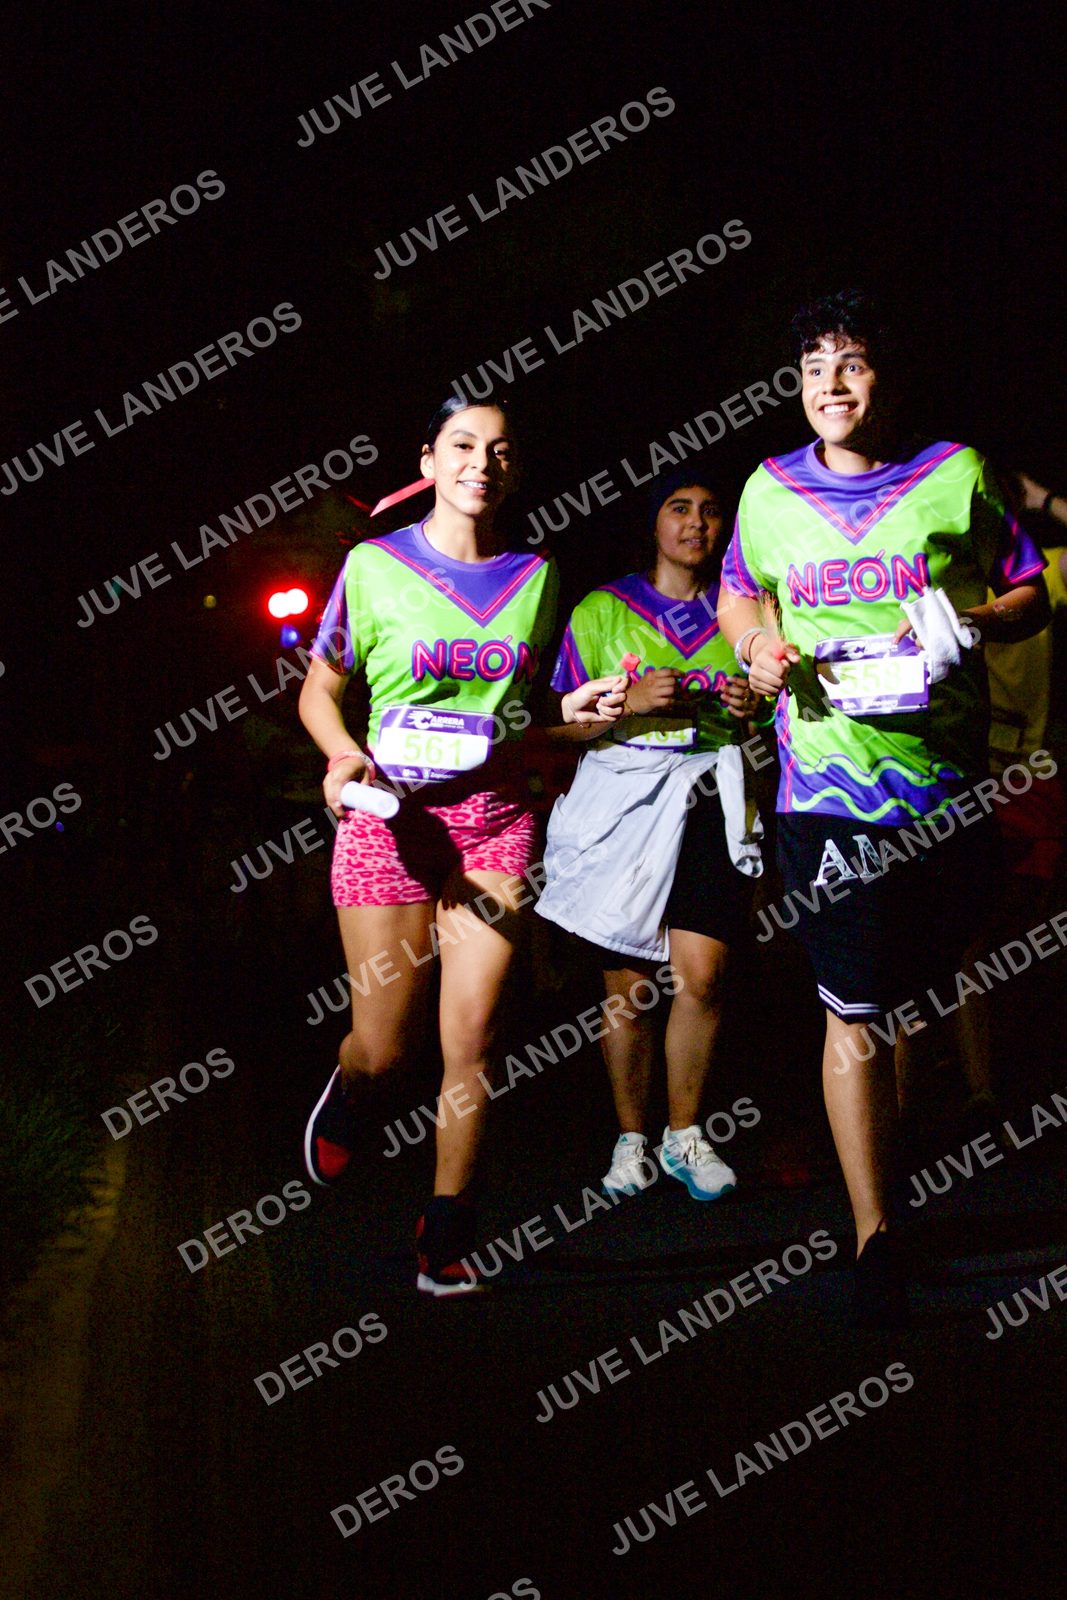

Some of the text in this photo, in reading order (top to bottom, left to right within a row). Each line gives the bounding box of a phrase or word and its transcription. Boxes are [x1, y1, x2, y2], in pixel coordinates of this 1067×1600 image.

[787, 549, 931, 608] NEÓN
[412, 635, 539, 683] NEÓN
[840, 661, 902, 695] 558
[402, 733, 462, 767] 561
